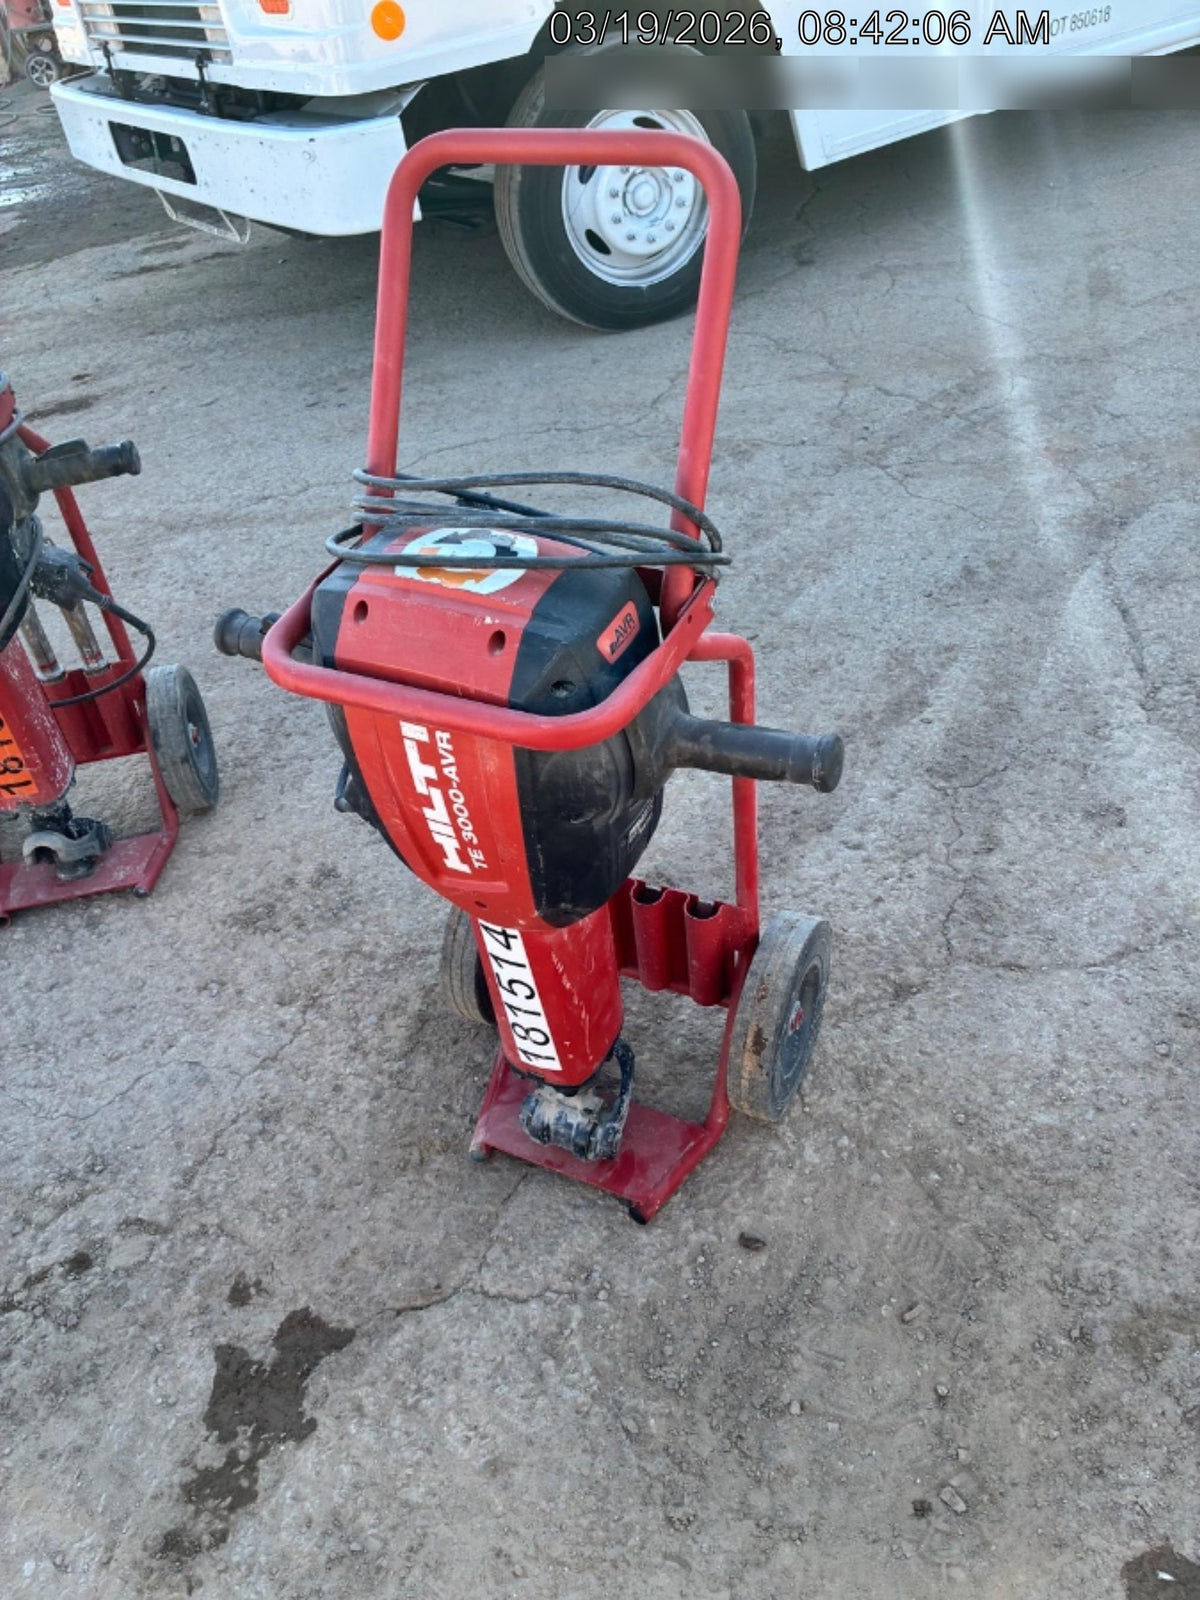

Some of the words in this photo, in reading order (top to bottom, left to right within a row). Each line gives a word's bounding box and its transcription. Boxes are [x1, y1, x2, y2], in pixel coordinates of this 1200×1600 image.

[611, 612, 636, 650] AVR
[399, 719, 472, 875] HILTI
[434, 730, 479, 846] 3000-AVR
[466, 847, 489, 870] TE
[479, 922, 557, 1063] 181514
